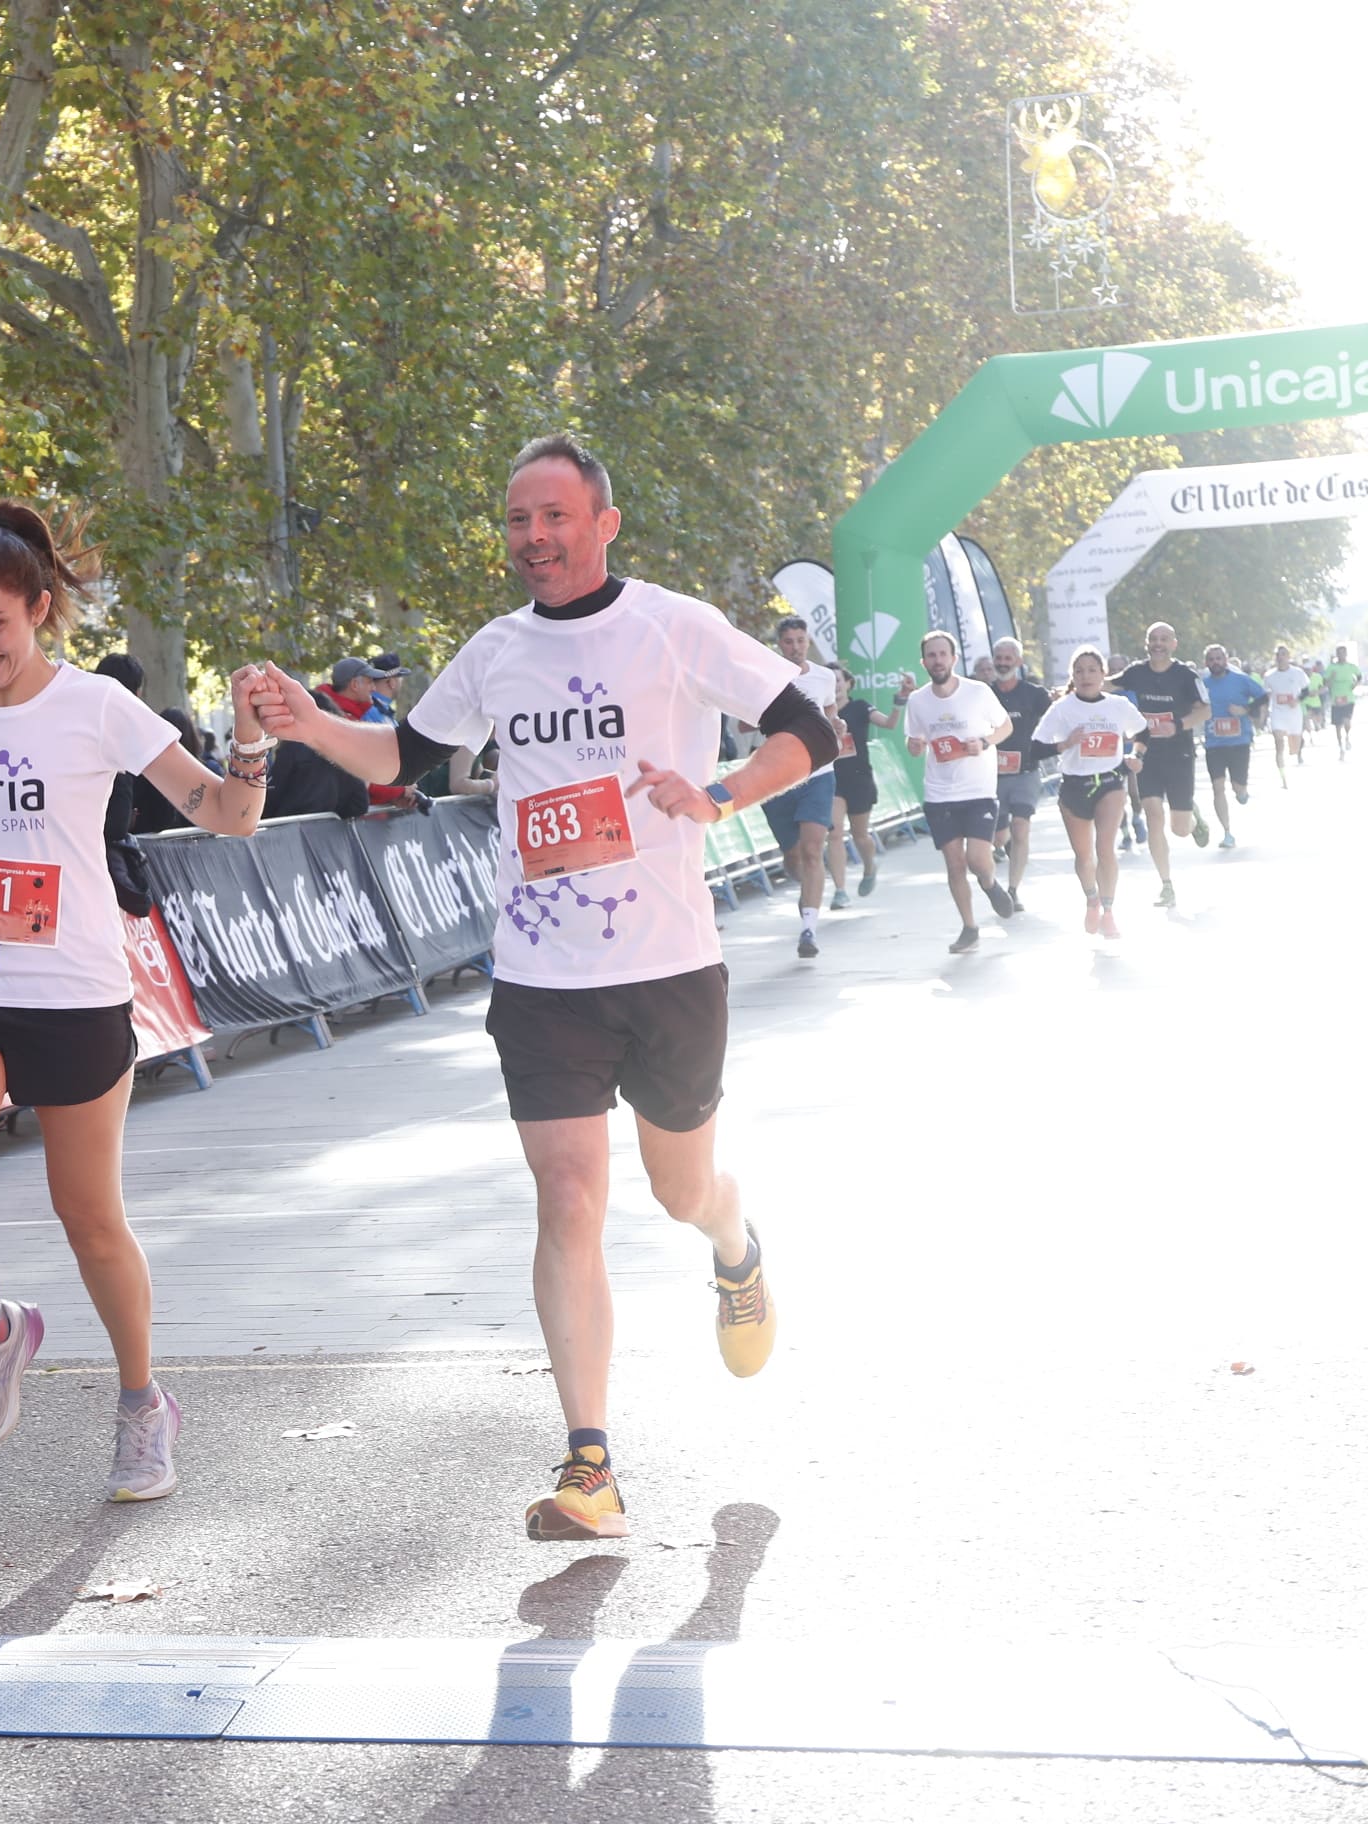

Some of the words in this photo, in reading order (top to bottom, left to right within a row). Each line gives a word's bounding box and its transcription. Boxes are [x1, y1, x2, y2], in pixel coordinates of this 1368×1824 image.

[1170, 485, 1205, 514] El
[1209, 481, 1279, 512] Norte
[1283, 480, 1311, 504] de
[509, 704, 625, 746] curia
[937, 741, 952, 754] 56
[1088, 736, 1103, 748] 57
[576, 745, 626, 761] SPAIN
[1, 817, 45, 832] SPAIN
[527, 803, 581, 848] 633
